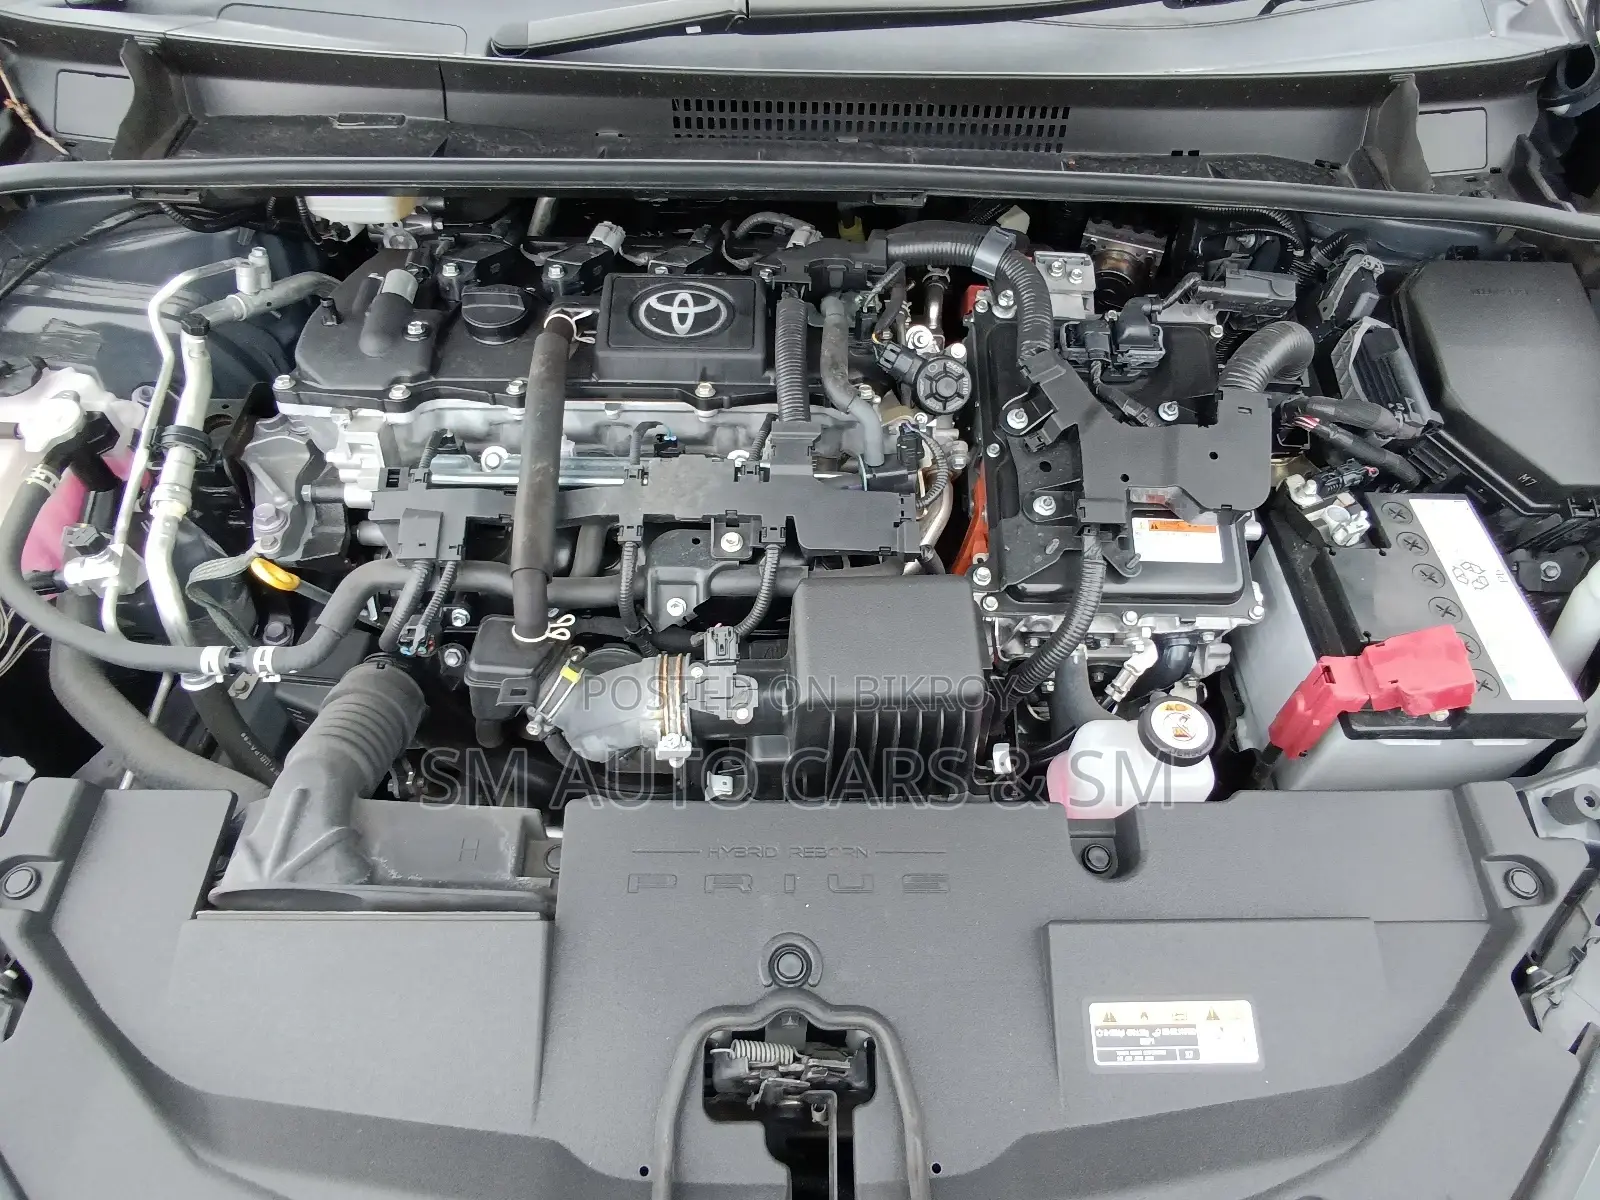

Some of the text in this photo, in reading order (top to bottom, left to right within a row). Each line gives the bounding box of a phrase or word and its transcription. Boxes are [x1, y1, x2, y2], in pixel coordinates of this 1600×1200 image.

[706, 846, 869, 858] HYBRID REBORN
[627, 873, 950, 893] PRIUS
